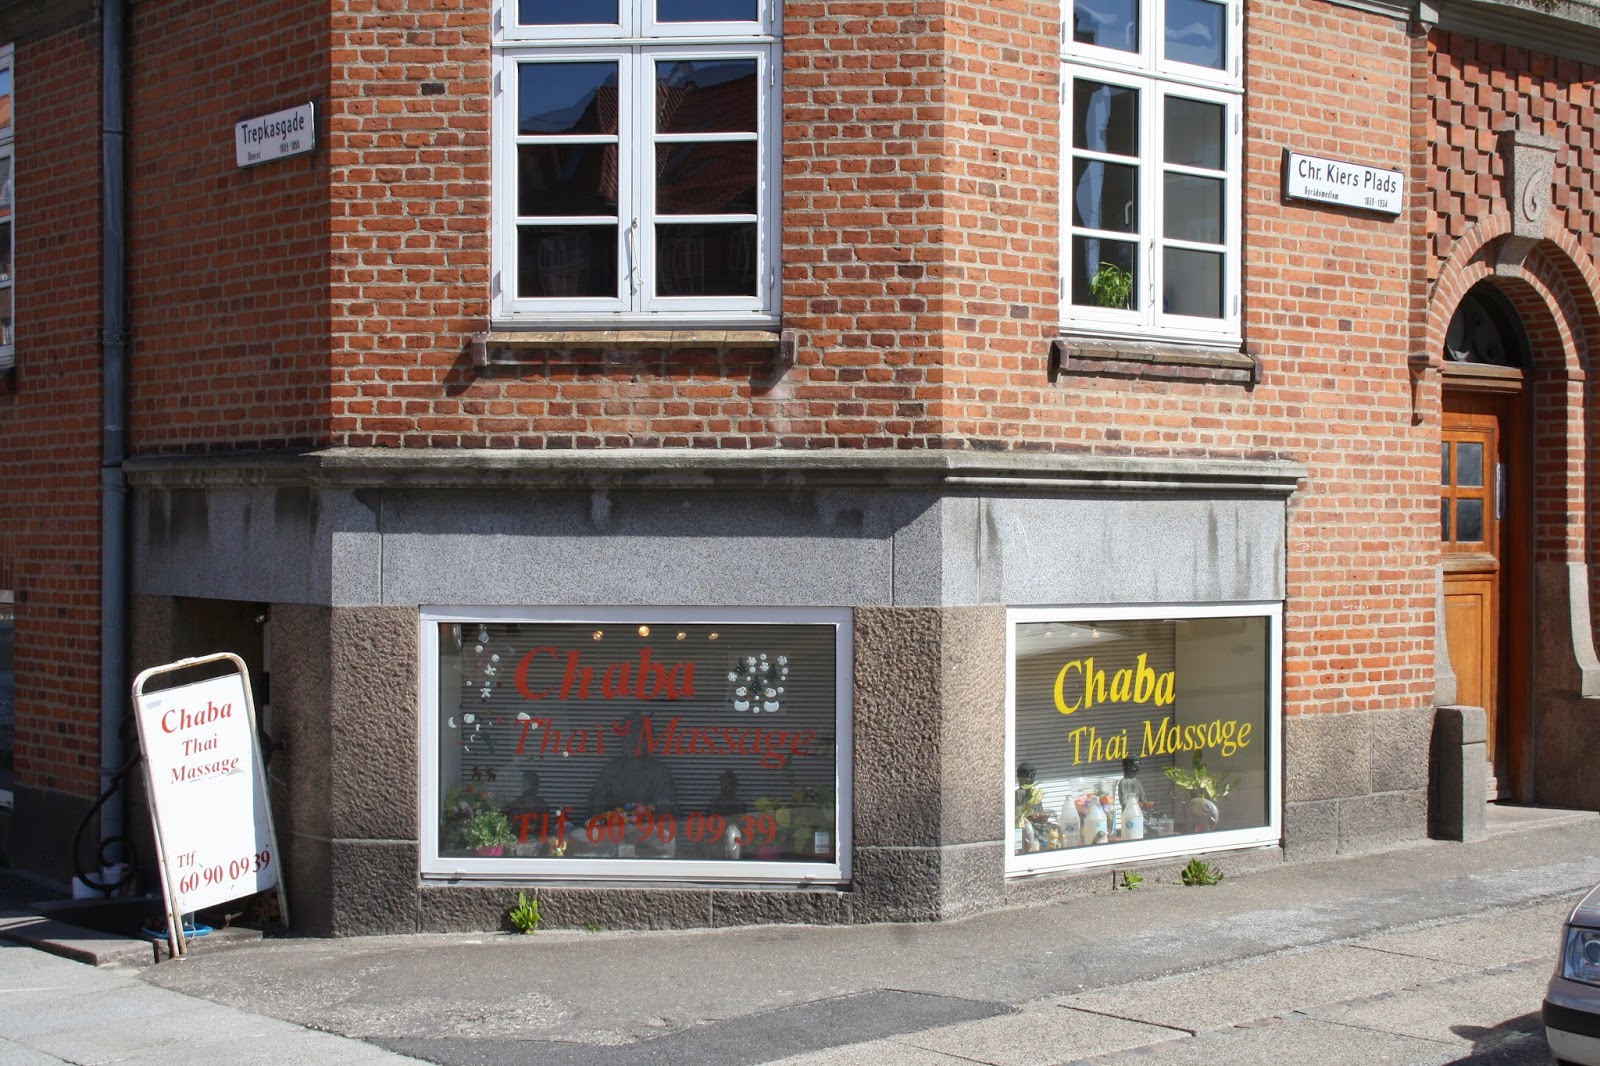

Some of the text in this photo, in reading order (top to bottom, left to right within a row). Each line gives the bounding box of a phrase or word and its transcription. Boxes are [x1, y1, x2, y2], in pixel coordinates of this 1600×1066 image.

[241, 111, 304, 144] Trepkasgade
[1298, 159, 1397, 194] Chr. Kiers Plads
[514, 646, 697, 701] Chaba
[1053, 652, 1176, 715] Chaba
[161, 701, 233, 734] Chaba
[181, 733, 218, 757] Thai
[512, 715, 815, 769] Thai Massage
[1068, 716, 1252, 766] Thai Massage
[170, 757, 240, 785] Massage
[586, 812, 625, 844] 60
[636, 811, 676, 844] 90
[685, 811, 726, 845] 09
[734, 813, 777, 846] 39
[180, 850, 271, 894] 60 90 09 39
